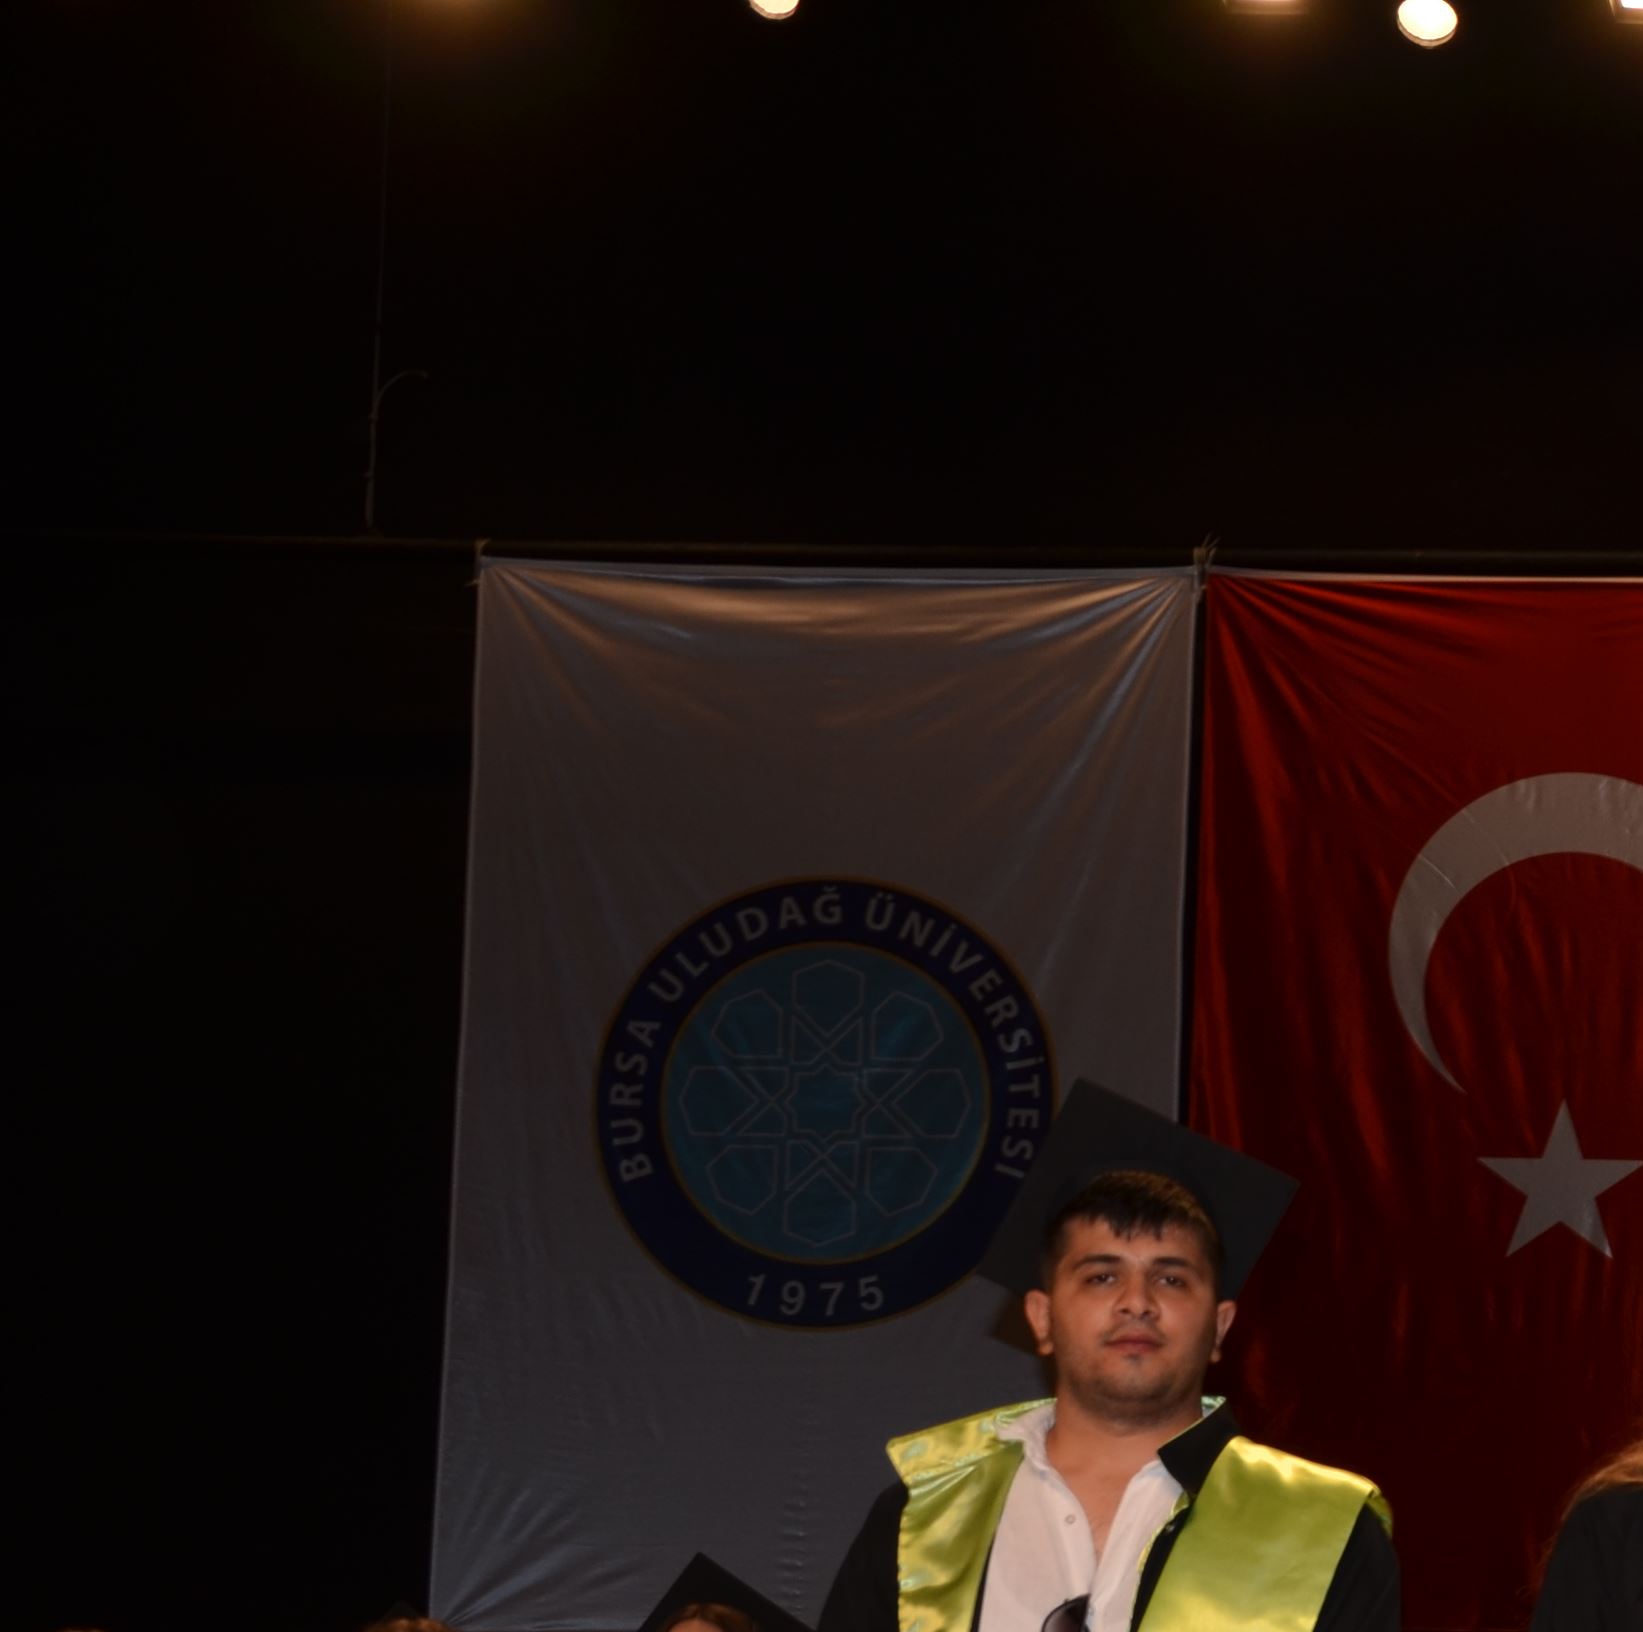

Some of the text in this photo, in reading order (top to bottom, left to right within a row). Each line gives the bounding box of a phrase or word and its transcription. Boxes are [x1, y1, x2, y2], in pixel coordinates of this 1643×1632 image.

[609, 1017, 662, 1182] BURSA
[647, 886, 843, 1004] ULUDAĞ
[746, 1272, 884, 1317] 1975
